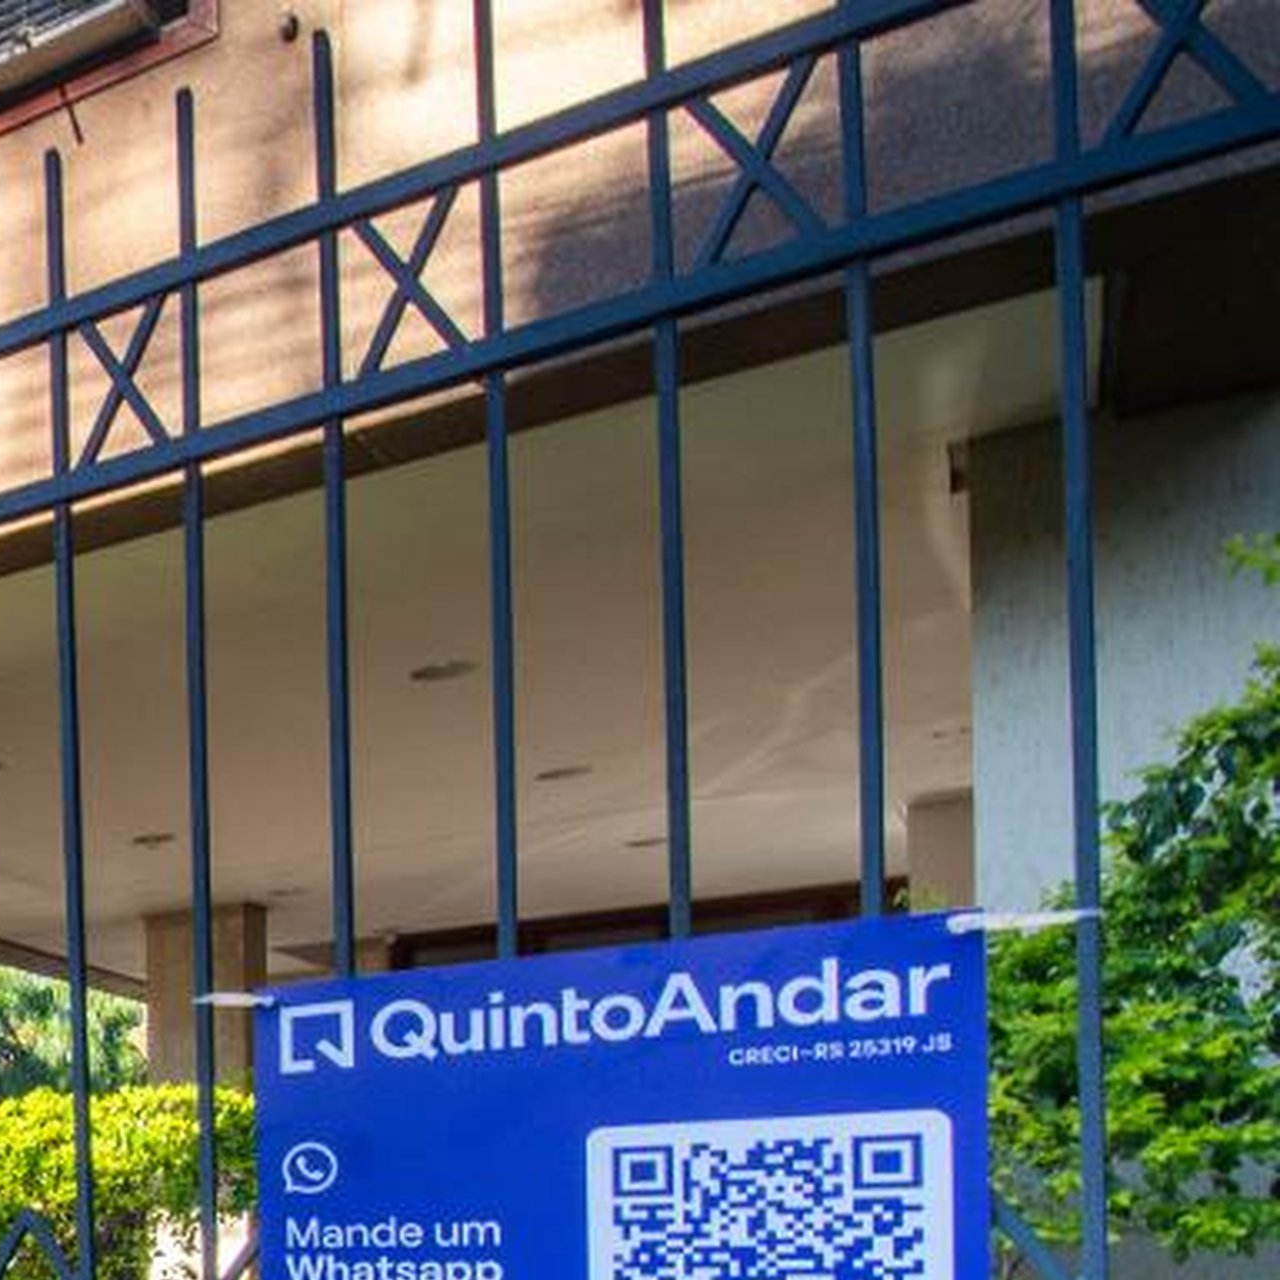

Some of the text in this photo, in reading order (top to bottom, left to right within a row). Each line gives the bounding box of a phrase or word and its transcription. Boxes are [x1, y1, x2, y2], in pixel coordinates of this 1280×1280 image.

[370, 958, 952, 1061] QuintoAndar
[285, 1217, 501, 1250] Mande um
